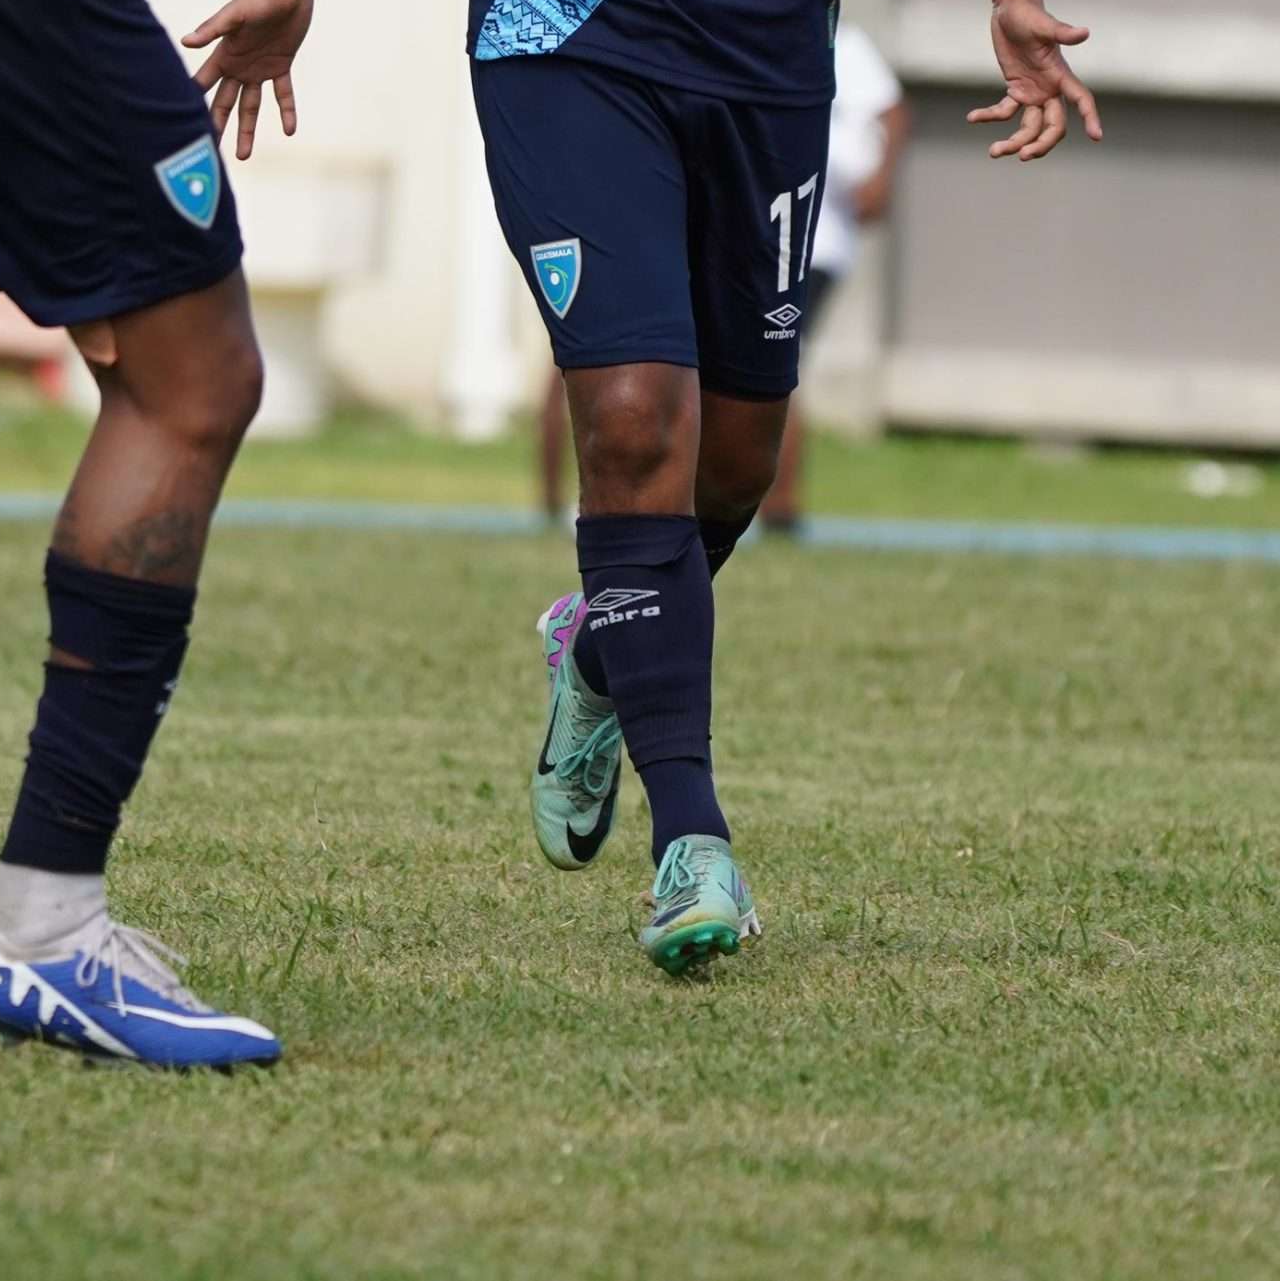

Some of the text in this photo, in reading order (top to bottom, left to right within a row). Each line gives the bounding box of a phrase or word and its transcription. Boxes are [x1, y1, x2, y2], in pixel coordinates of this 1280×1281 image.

[770, 172, 819, 293] 17
[763, 328, 796, 341] umbro
[589, 606, 662, 632] mbro
